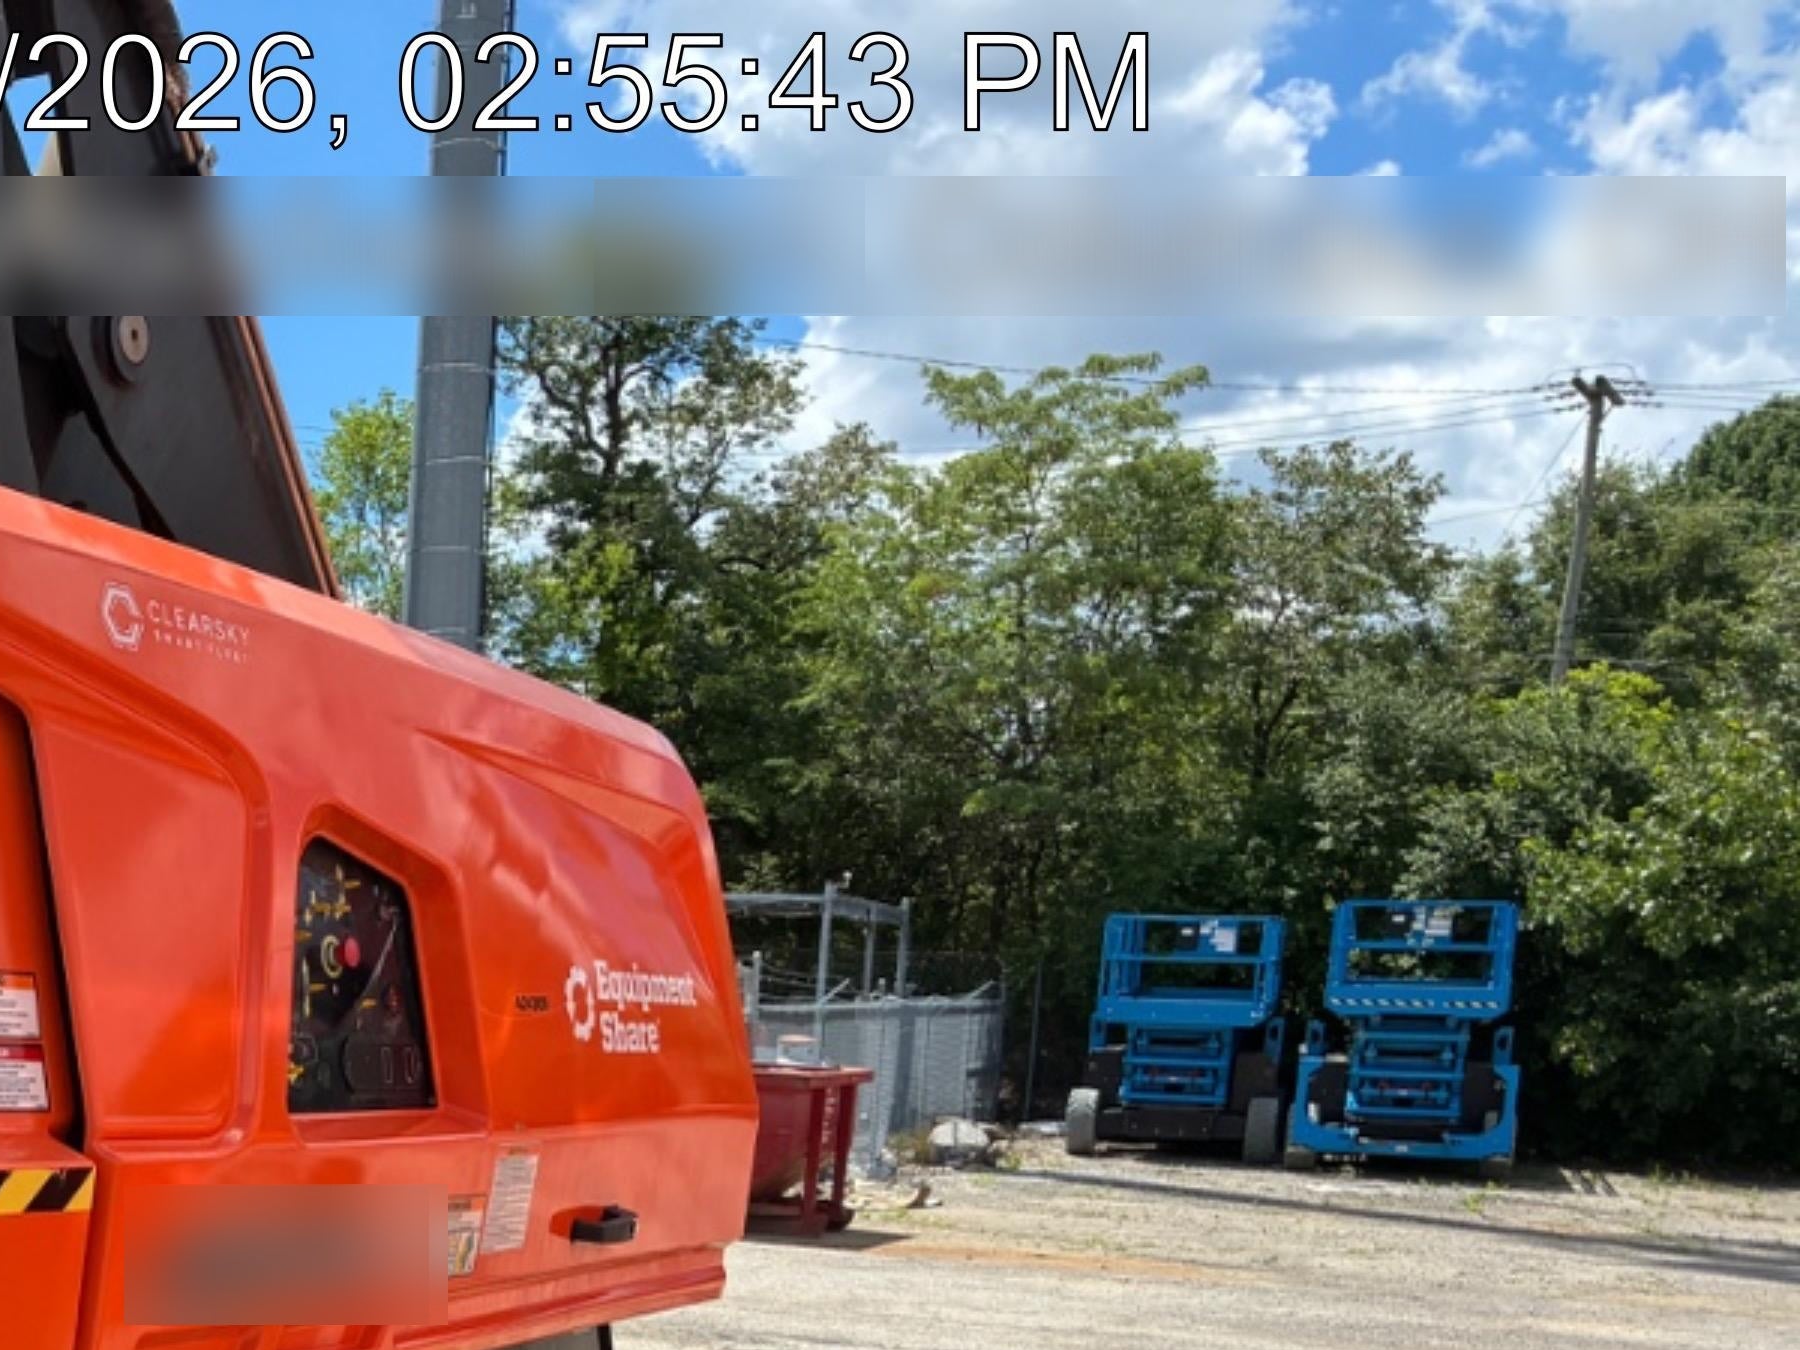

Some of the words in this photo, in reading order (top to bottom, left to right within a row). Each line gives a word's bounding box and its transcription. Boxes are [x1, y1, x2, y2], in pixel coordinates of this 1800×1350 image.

[146, 599, 250, 646] CLEARSKY
[593, 959, 698, 1013] Equipment
[600, 1011, 660, 1054] Share
